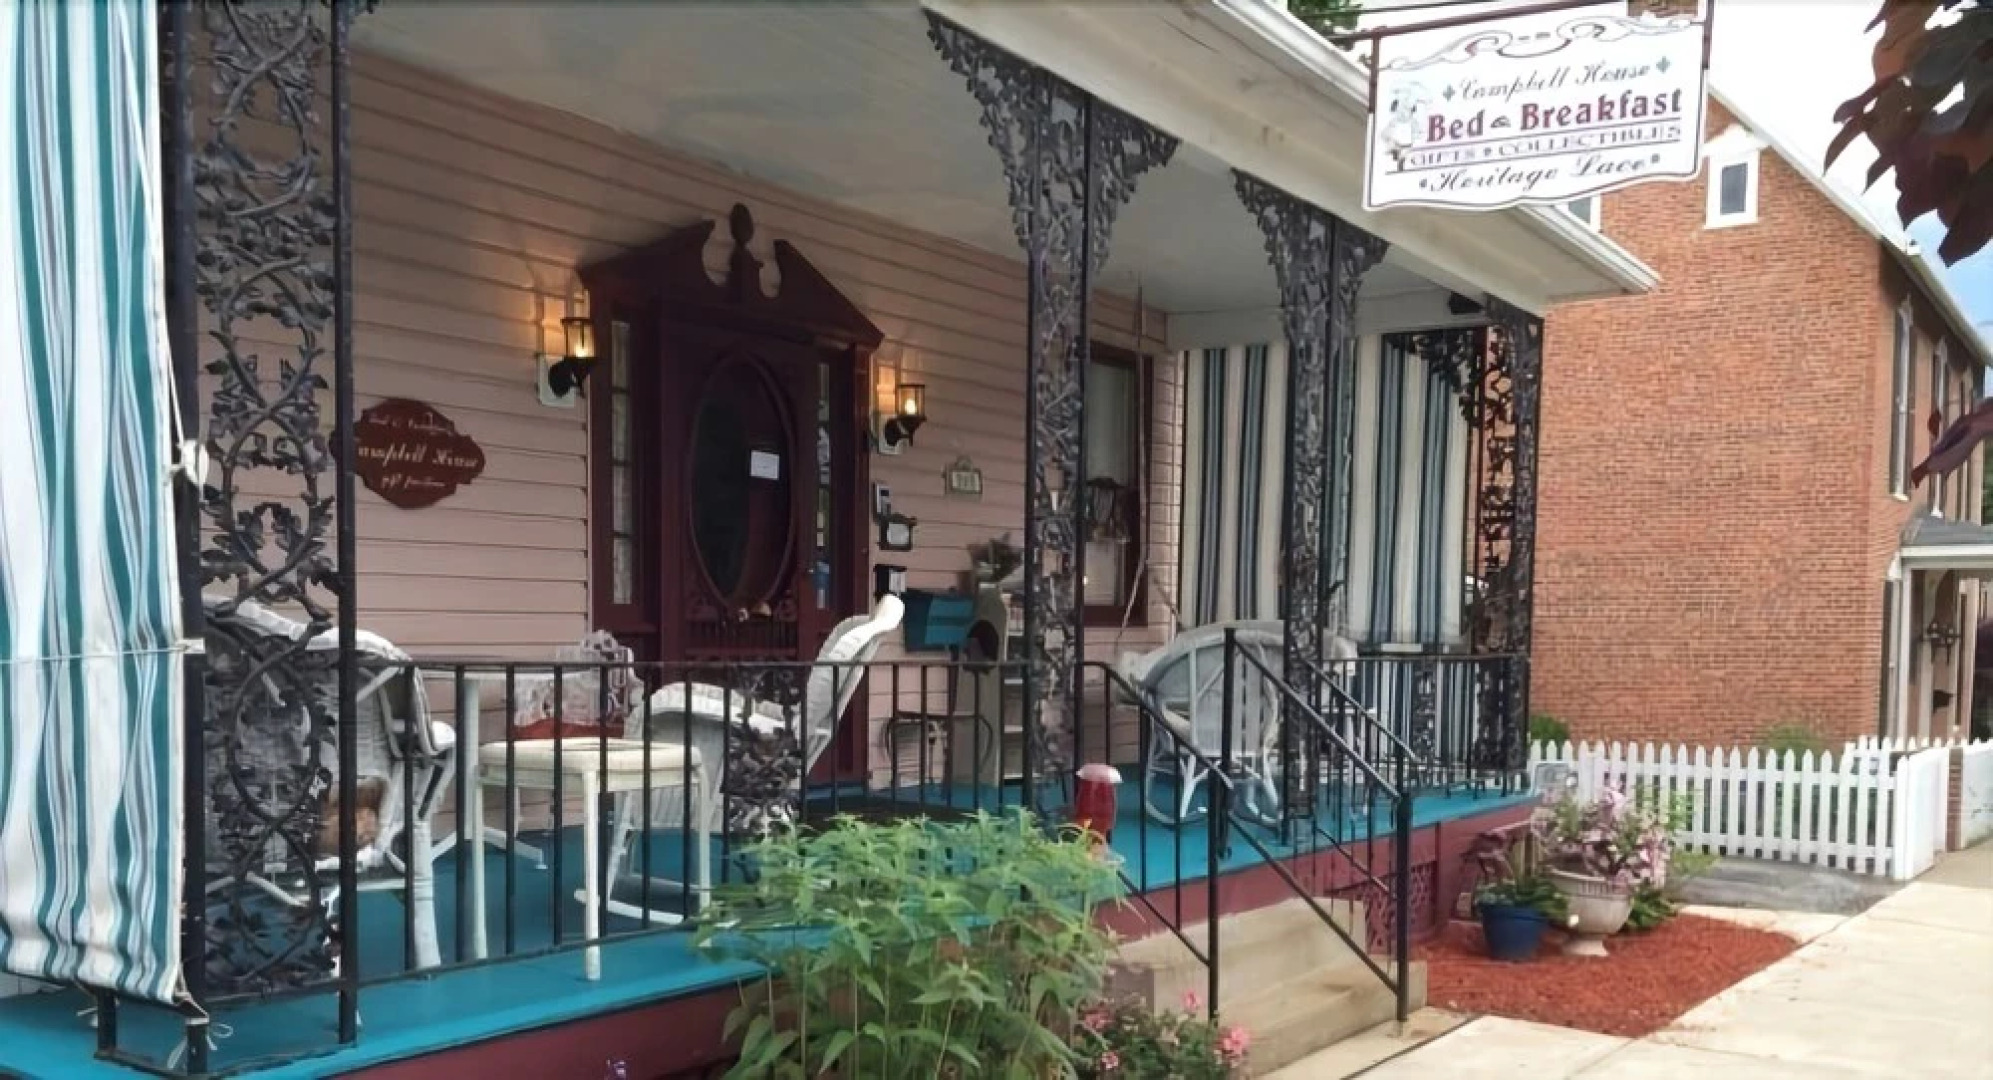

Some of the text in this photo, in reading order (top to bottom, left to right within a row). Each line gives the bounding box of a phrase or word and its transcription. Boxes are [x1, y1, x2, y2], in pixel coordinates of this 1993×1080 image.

[1460, 59, 1650, 103] Campbell House
[1426, 108, 1485, 142] Bed
[1520, 87, 1682, 130] Breakfast
[1410, 126, 1681, 165] GIFTS COLLECTIBLES
[1430, 154, 1645, 192] Heritage Lace
